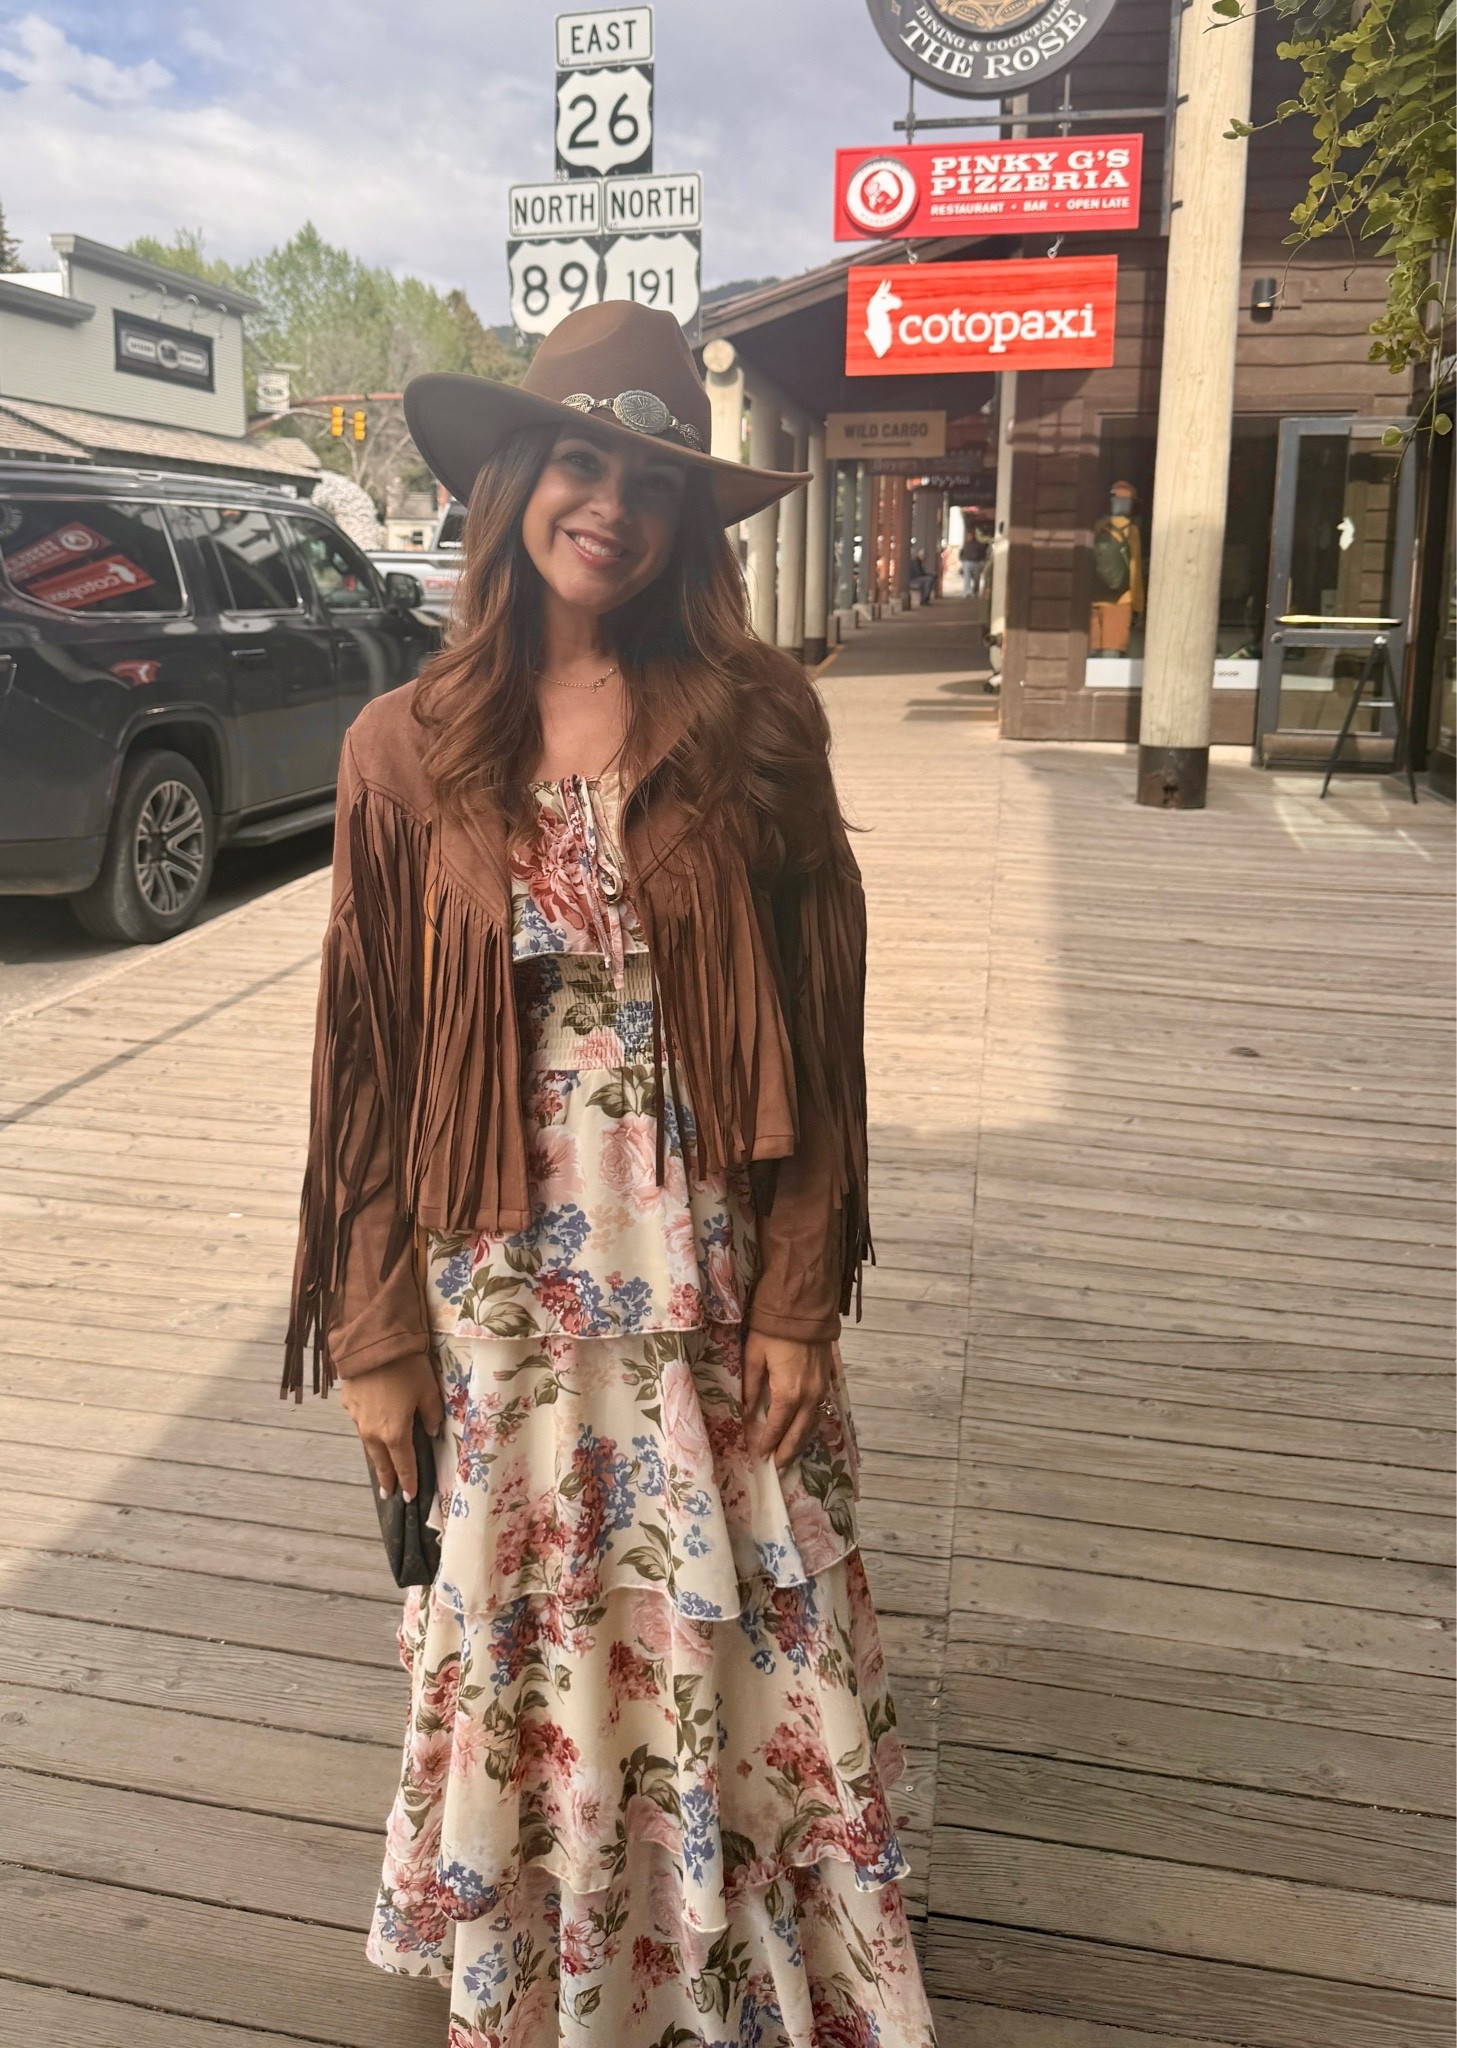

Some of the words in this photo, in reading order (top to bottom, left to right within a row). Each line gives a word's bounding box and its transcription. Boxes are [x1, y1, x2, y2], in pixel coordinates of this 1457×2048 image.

[571, 20, 636, 54] EAST
[900, 19, 974, 78] THE
[983, 9, 1088, 79] ROSE
[916, 6, 965, 49] DINING
[968, 40, 982, 52] &
[568, 93, 639, 150] 26
[931, 152, 1058, 176] PINKY
[1067, 149, 1130, 170] G'S
[930, 170, 1129, 196] PIZZERIA
[514, 193, 594, 226] NORTH
[611, 186, 694, 220] NORTH
[930, 202, 1004, 216] RESTAURANT
[1023, 200, 1048, 211] BAR
[1066, 198, 1099, 210] OPEN
[1101, 197, 1130, 208] LATE
[523, 261, 588, 317] 89
[627, 267, 674, 305] 191
[900, 303, 1097, 353] cotopaxi
[844, 424, 878, 438] WILD
[882, 423, 928, 437] CARGO
